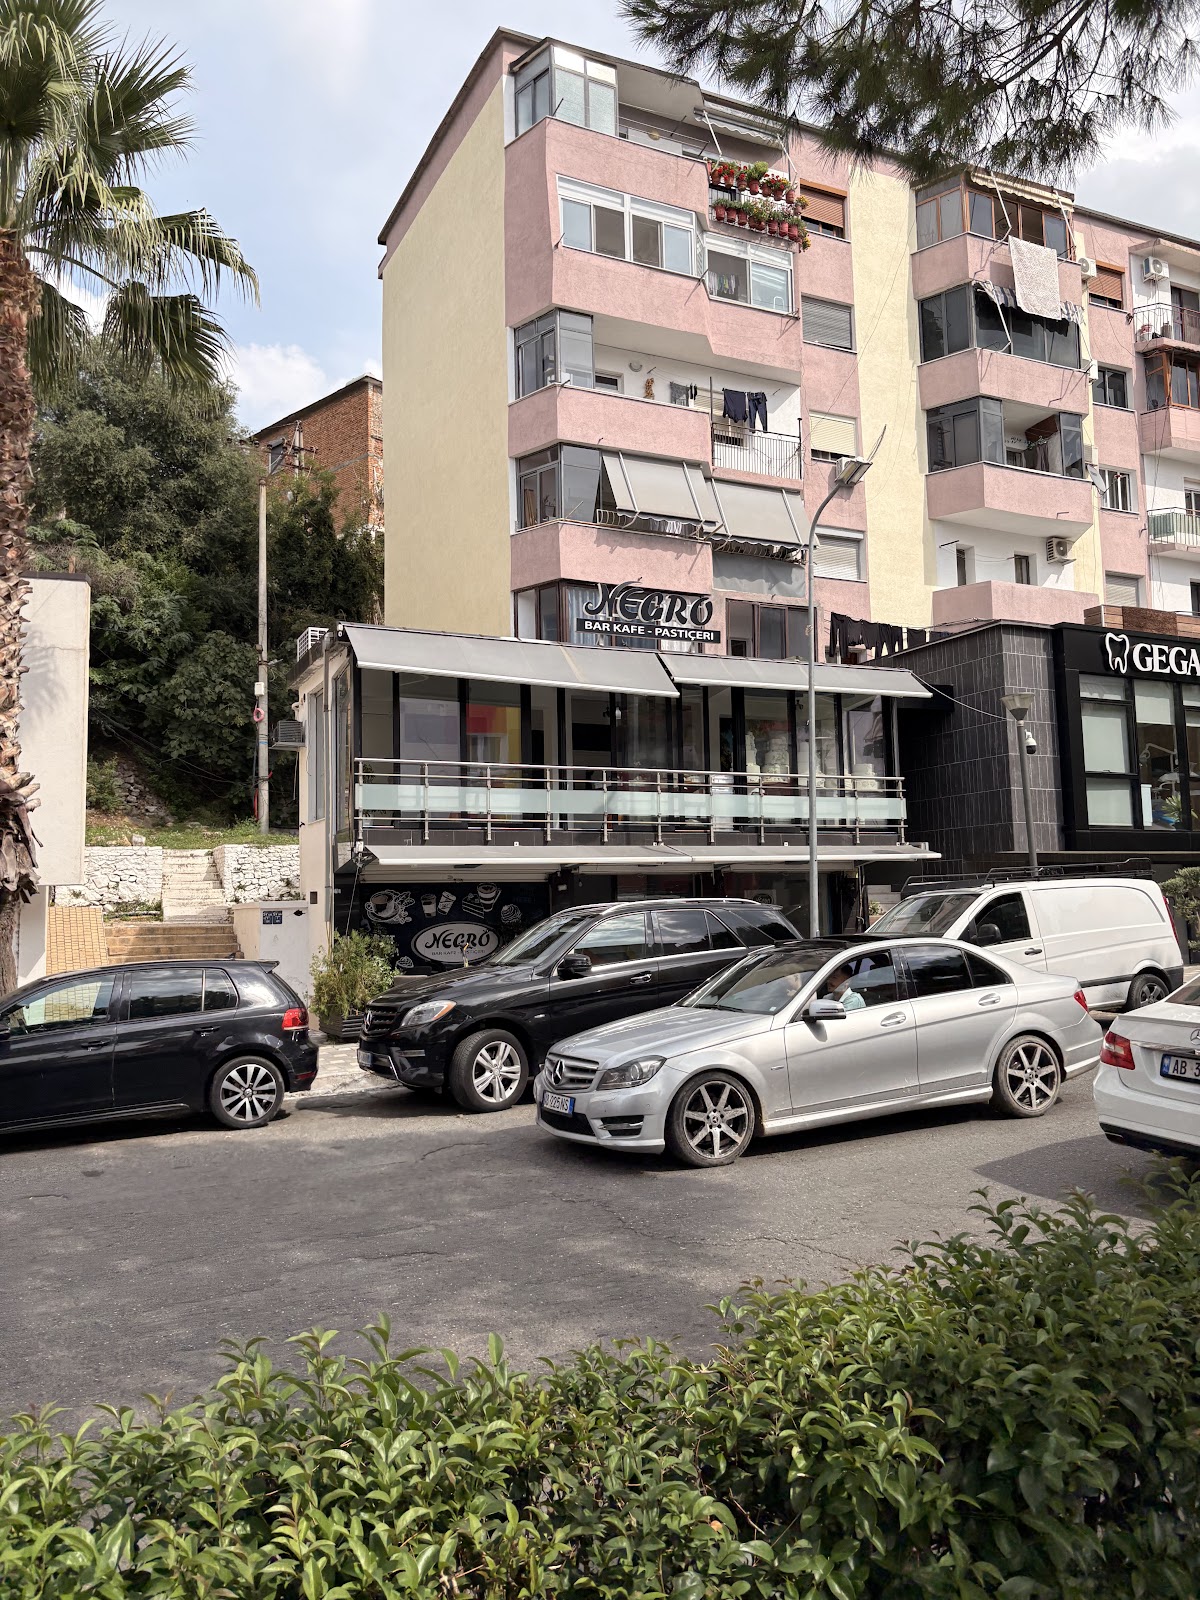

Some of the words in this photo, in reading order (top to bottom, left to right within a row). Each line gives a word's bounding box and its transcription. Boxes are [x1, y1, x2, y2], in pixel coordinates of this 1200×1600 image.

[583, 580, 713, 626] NEGRO
[584, 620, 610, 632] BAR
[613, 623, 645, 635] KAFE
[655, 628, 714, 641] PASTIÇERI
[1132, 643, 1200, 677] GEGA
[1173, 1060, 1187, 1074] AB
